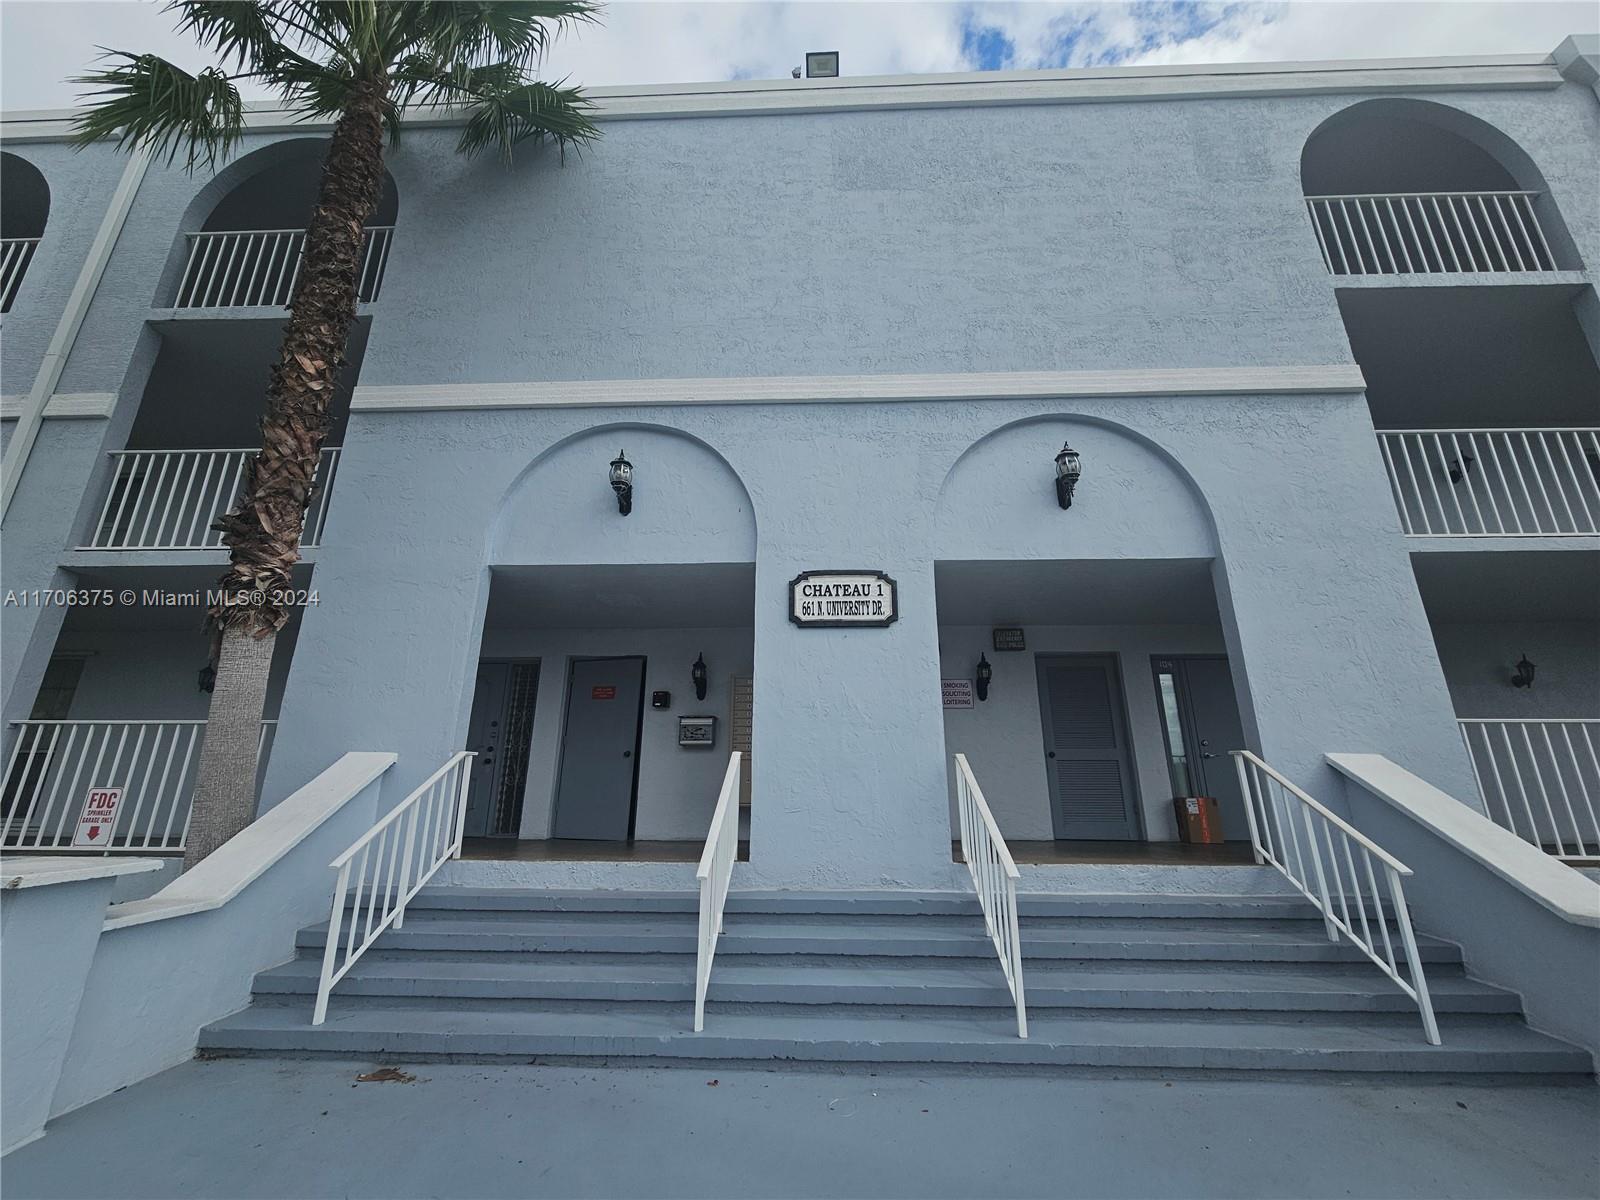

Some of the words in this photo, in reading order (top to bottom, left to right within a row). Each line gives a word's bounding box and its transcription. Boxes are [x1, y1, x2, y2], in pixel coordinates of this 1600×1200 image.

[802, 584, 871, 597] CHATEAU
[877, 584, 884, 596] 1
[802, 601, 815, 616] 661
[817, 601, 825, 616] N.
[826, 600, 870, 616] UNIVERSITY
[872, 601, 885, 616] DR.
[88, 792, 117, 809] FDC
